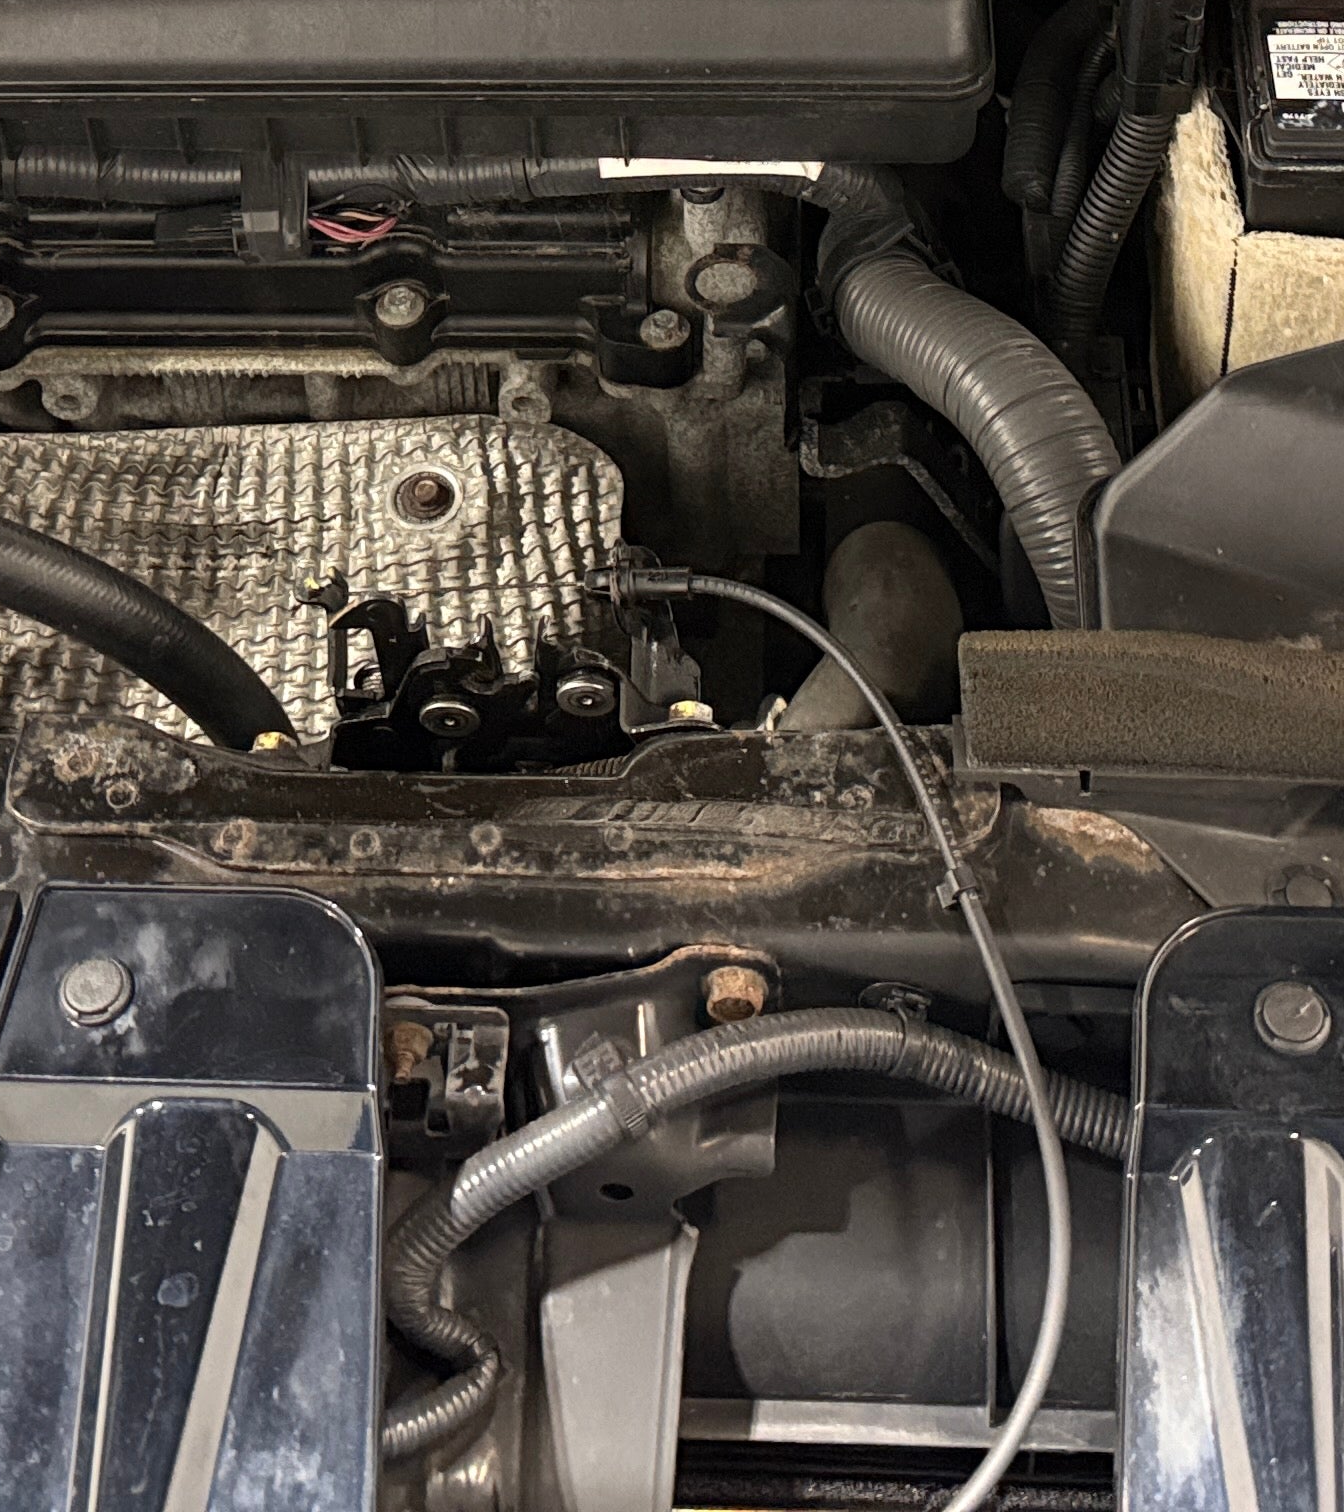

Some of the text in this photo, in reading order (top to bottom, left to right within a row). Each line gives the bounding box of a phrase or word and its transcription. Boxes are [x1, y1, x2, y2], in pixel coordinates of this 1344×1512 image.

[1301, 55, 1325, 63] HELP
[1275, 63, 1316, 71] MEDICAL
[1276, 70, 1293, 78] GET
